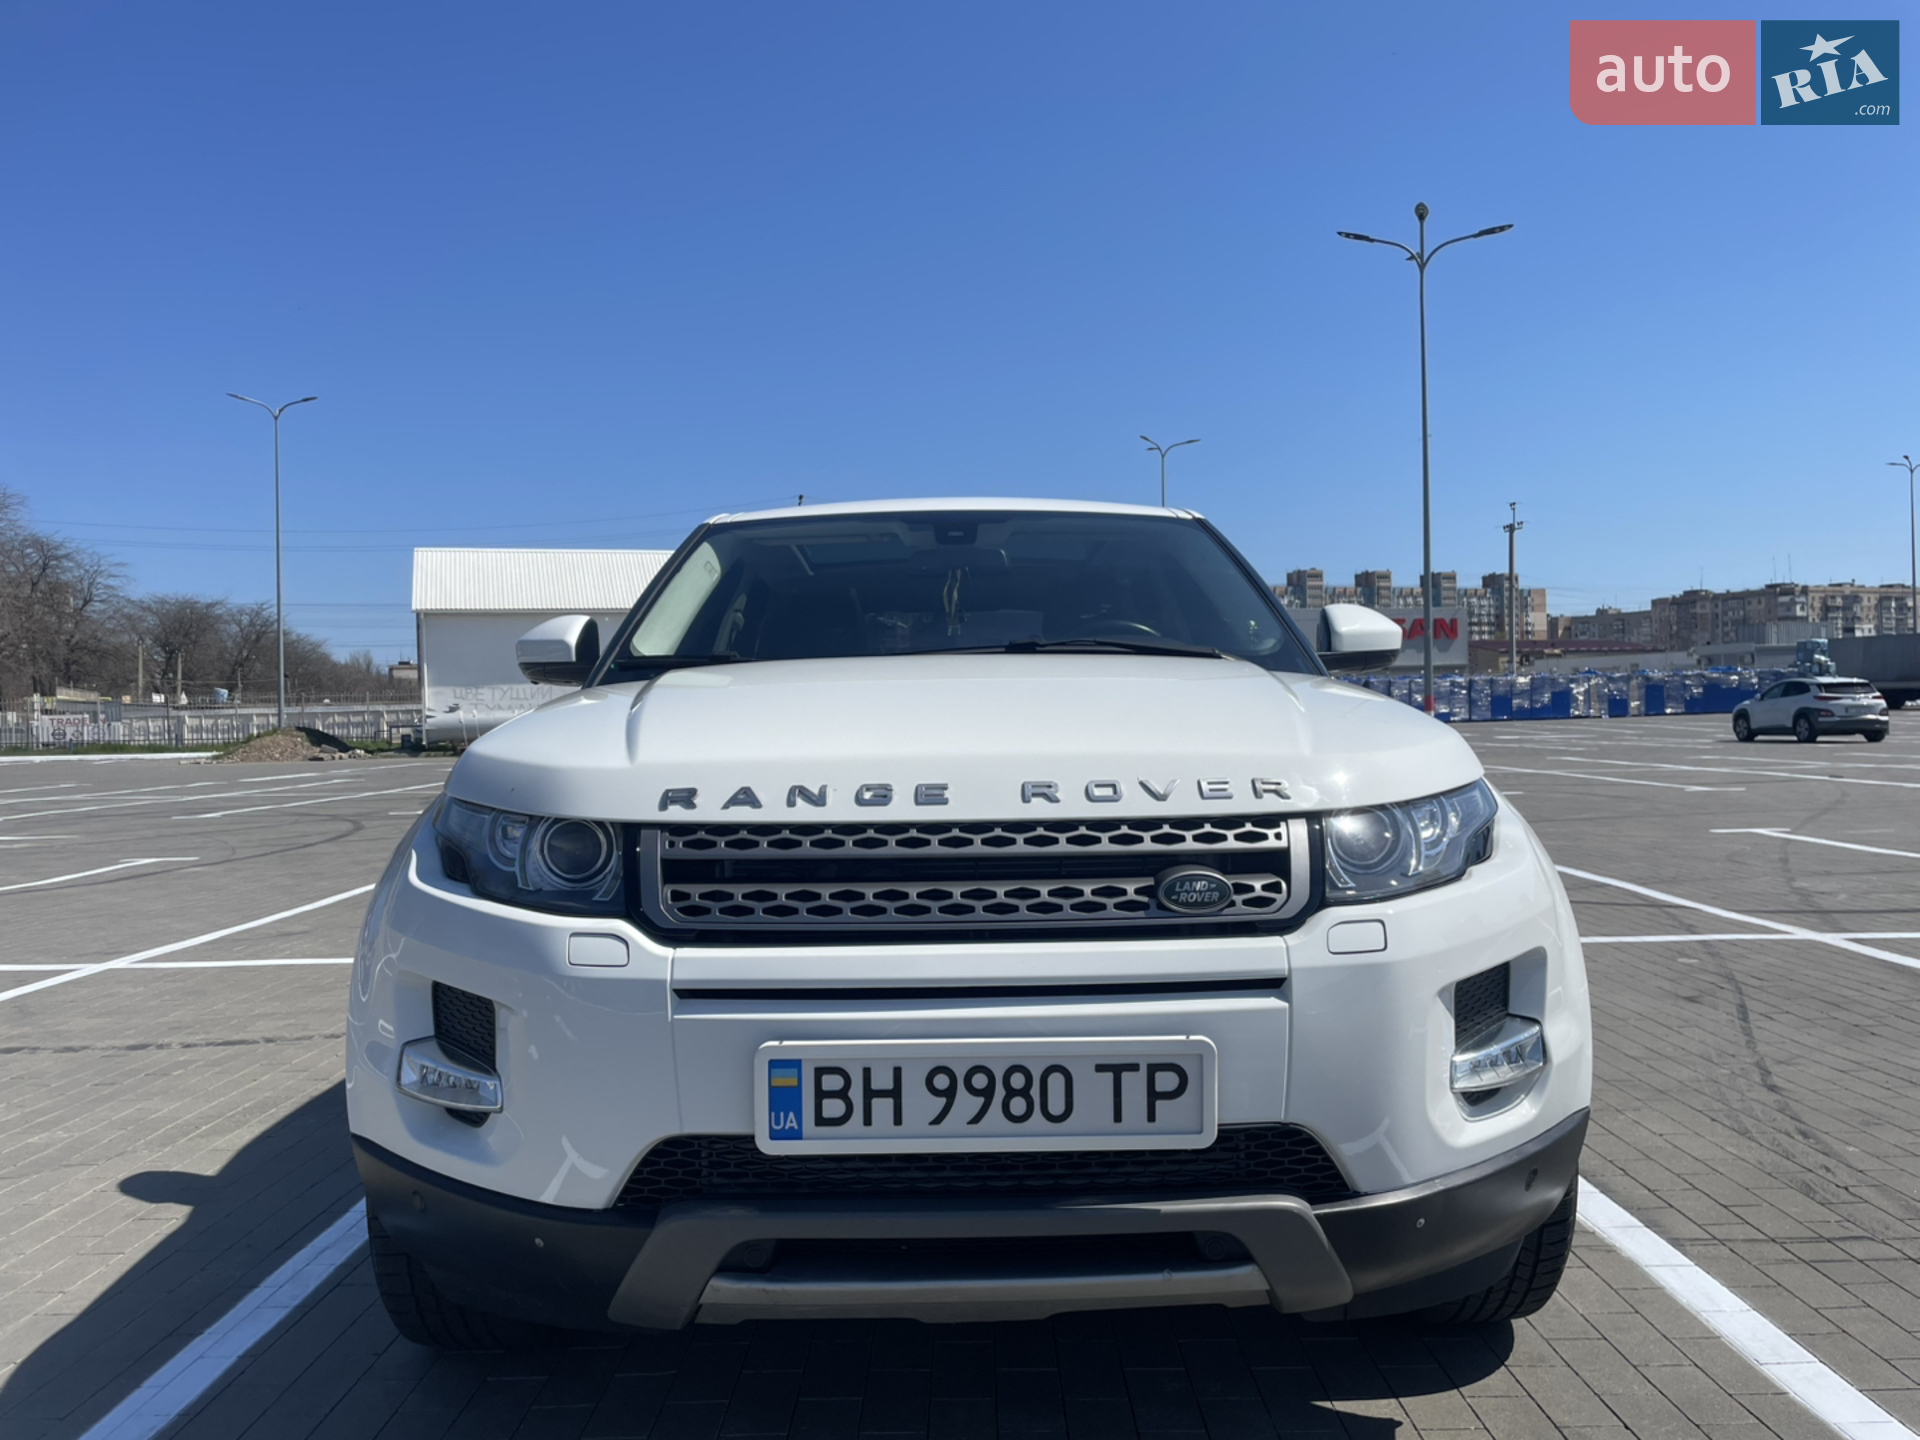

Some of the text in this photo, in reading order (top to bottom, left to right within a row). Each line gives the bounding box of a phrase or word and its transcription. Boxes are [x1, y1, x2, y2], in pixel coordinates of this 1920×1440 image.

[658, 778, 1292, 812] RANGE ROVER
[1175, 880, 1209, 892] LAND
[1178, 891, 1220, 903] ROVER
[814, 1063, 1189, 1127] BH 9980 TP
[771, 1111, 799, 1130] UA
